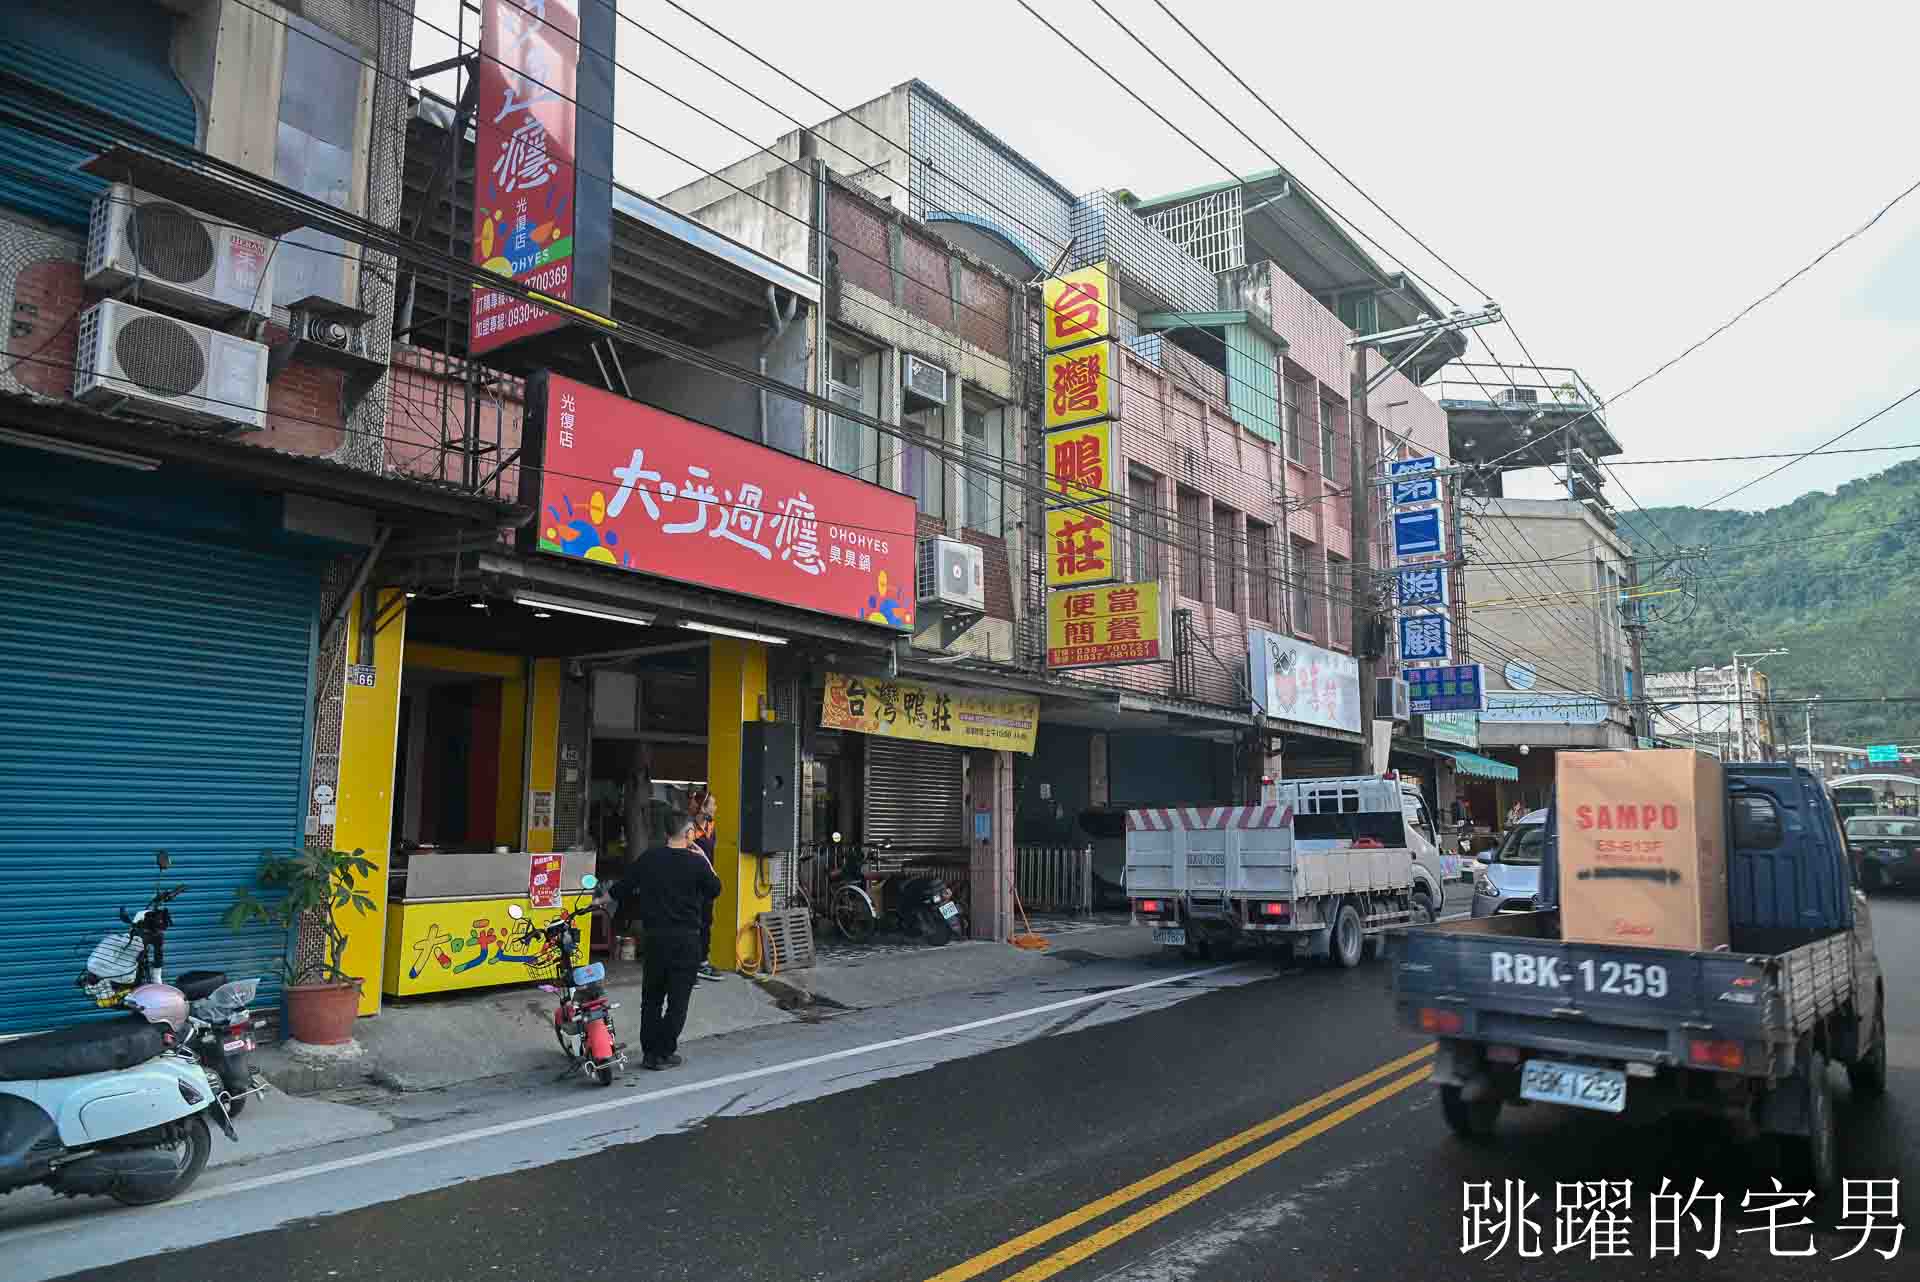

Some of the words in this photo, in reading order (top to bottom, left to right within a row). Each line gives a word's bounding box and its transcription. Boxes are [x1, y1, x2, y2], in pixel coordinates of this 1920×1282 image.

[559, 393, 576, 449] 光復店
[1053, 281, 1105, 577] 台灣鴨莊
[606, 448, 827, 576] 大呼過癮
[829, 525, 889, 554] OHOHYES
[1064, 587, 1139, 618] 便當
[847, 678, 953, 732] 台灣鴨莊
[1575, 804, 1680, 831] SAMPO
[1490, 951, 1669, 998] RBK-1259
